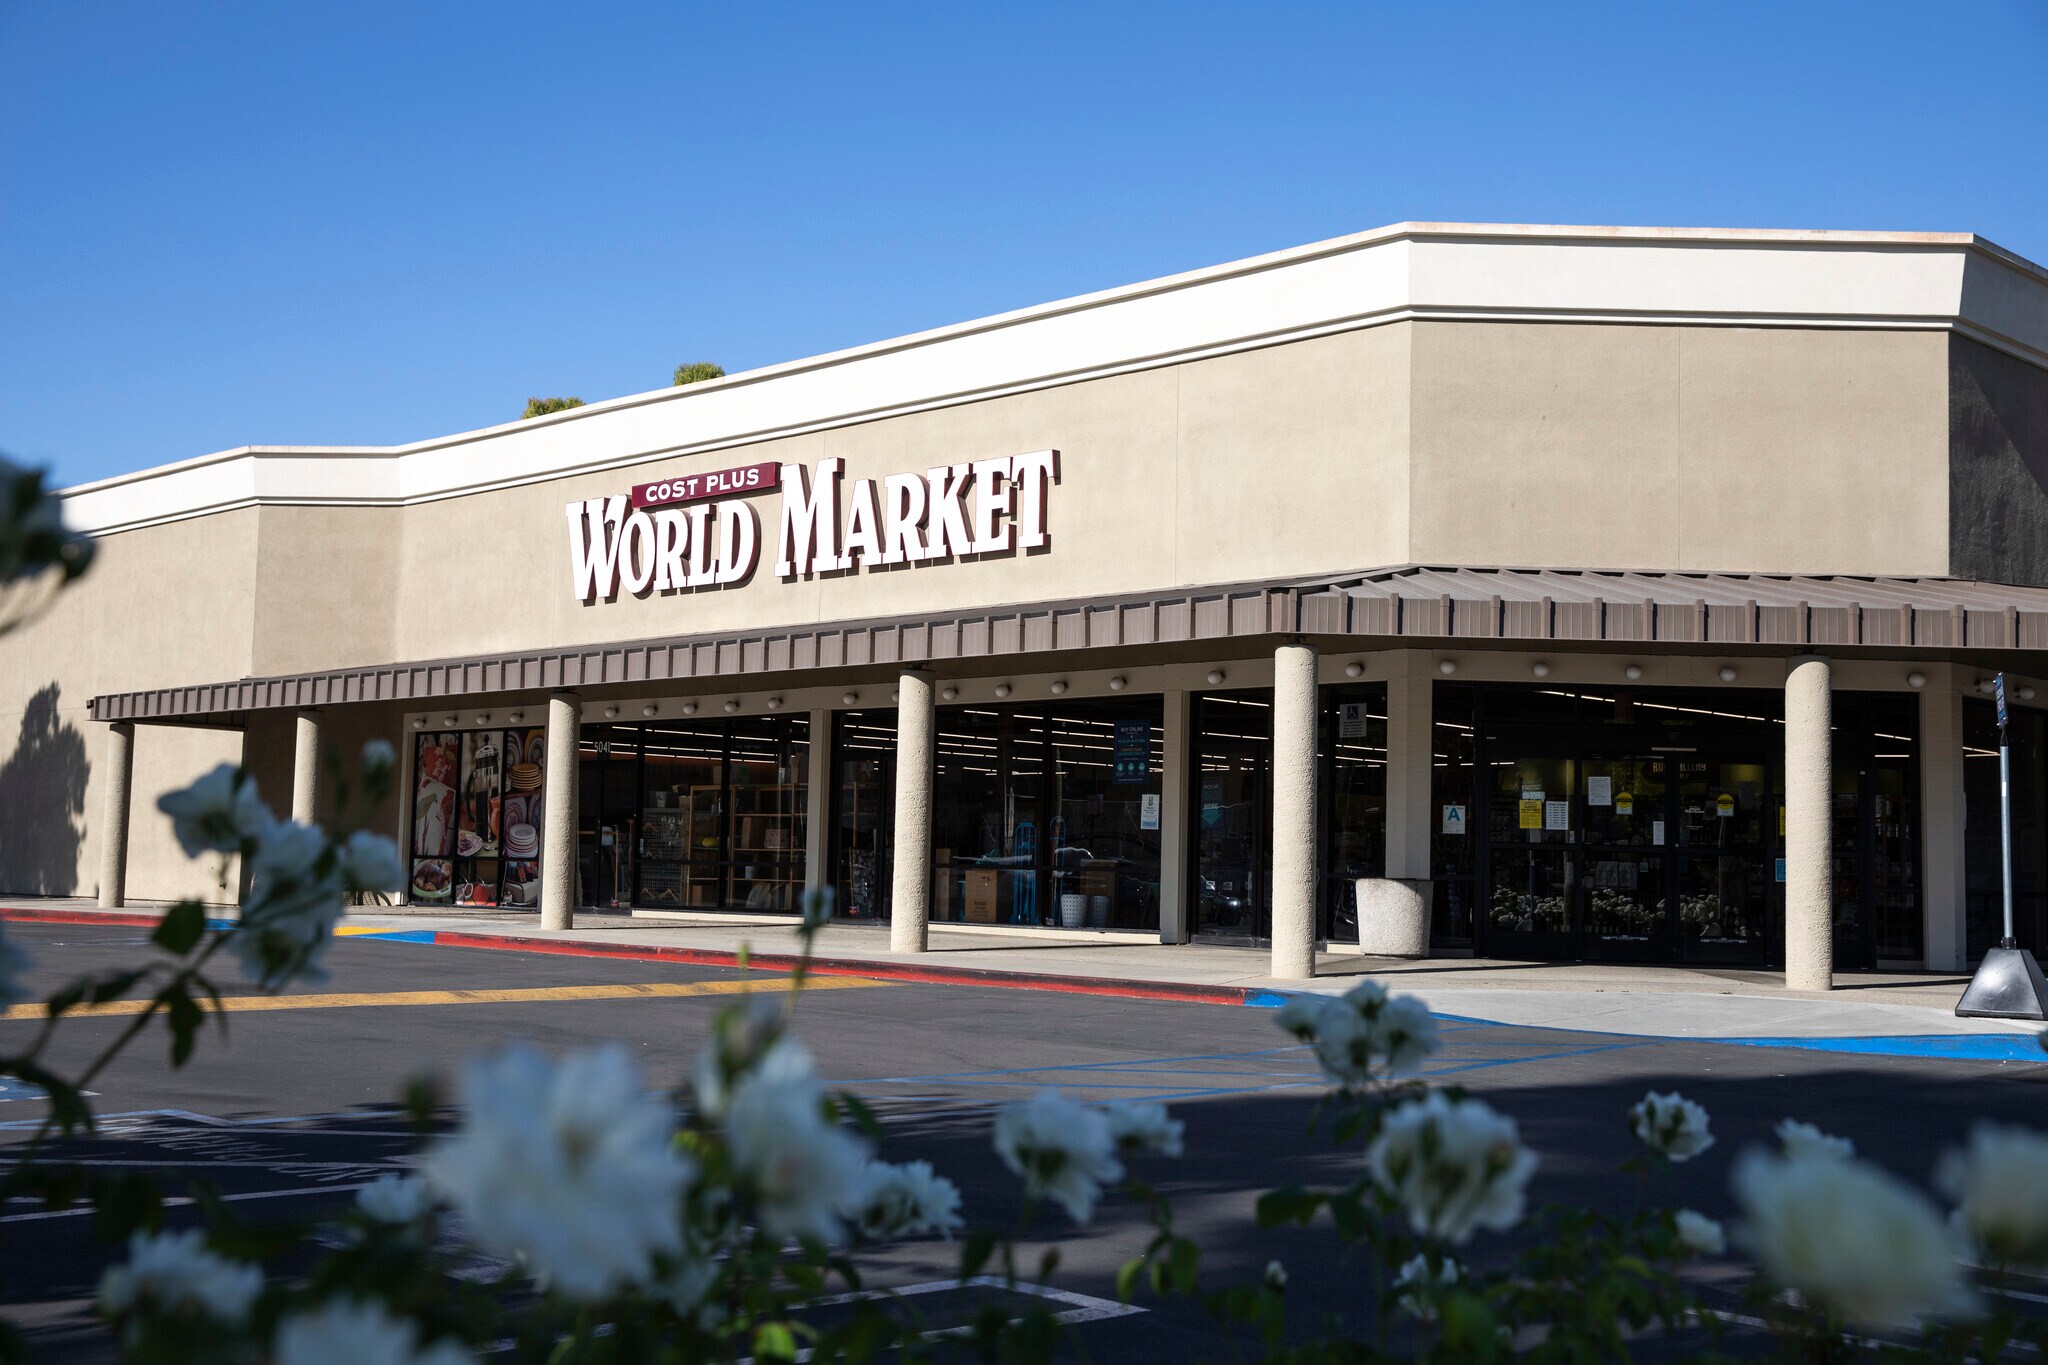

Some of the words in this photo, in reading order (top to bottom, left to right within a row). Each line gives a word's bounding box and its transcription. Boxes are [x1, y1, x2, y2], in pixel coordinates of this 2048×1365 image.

[645, 479, 699, 502] COST
[706, 468, 759, 493] PLUS
[565, 493, 758, 601] WORLD
[774, 449, 1056, 577] MARKET
[594, 741, 610, 753] 5041
[1652, 762, 1664, 773] RU
[1679, 762, 1706, 772] ALLERY
[1447, 807, 1460, 821] A
